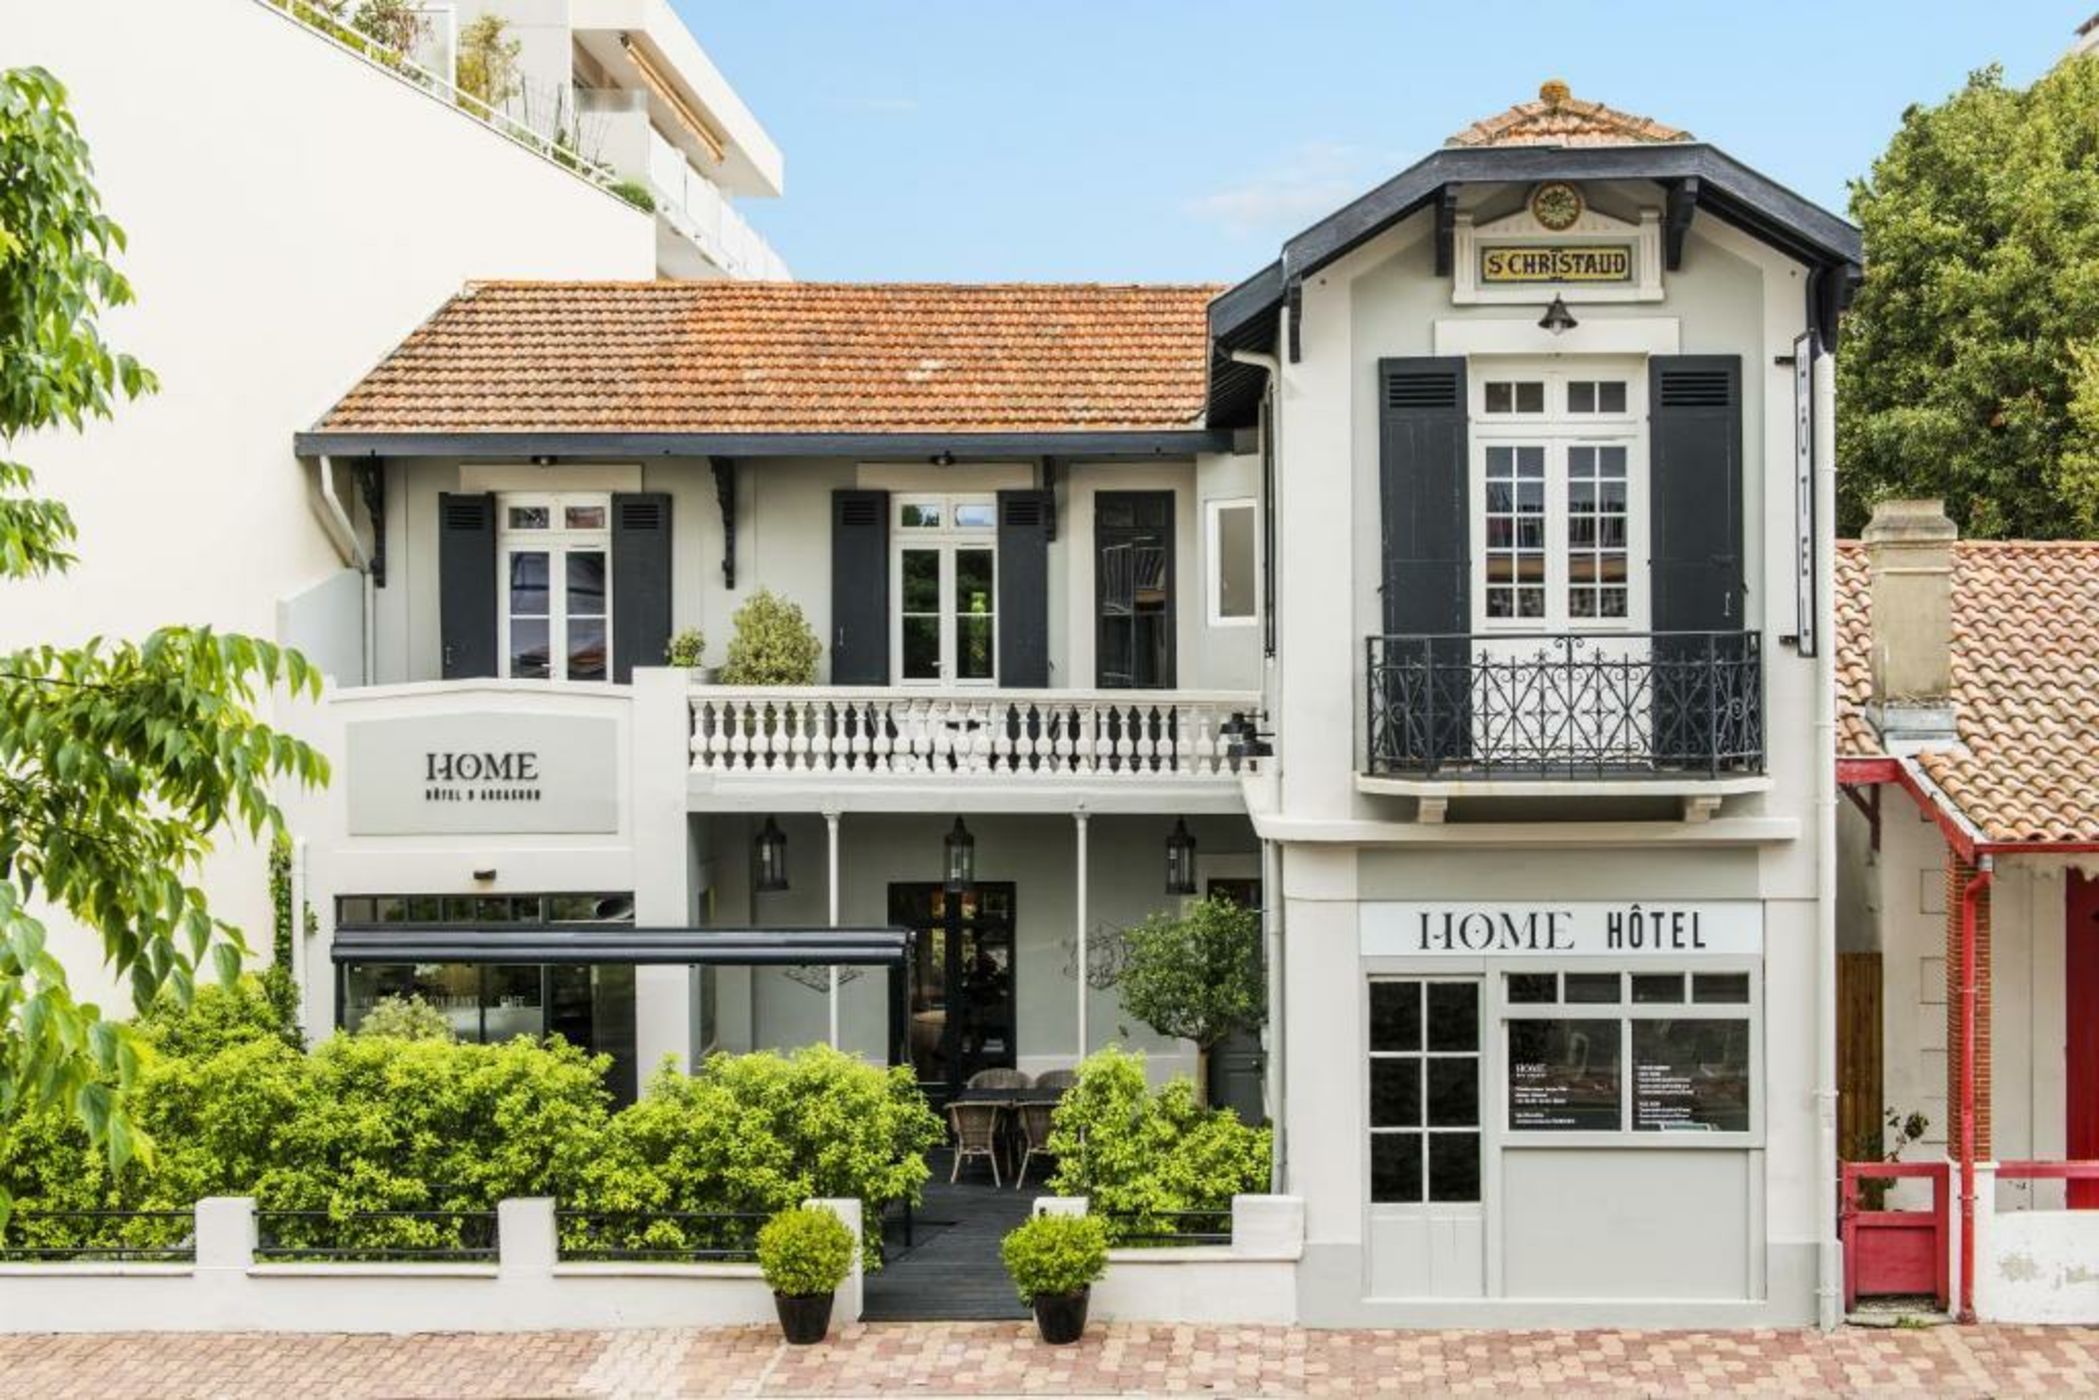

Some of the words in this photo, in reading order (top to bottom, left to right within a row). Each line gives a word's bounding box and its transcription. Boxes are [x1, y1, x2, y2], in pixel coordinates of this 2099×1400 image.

[1508, 253, 1625, 274] CHRISTAUD
[425, 752, 539, 781] HOME
[1418, 911, 1575, 950] HOME
[1607, 903, 1706, 949] HÔTEL
